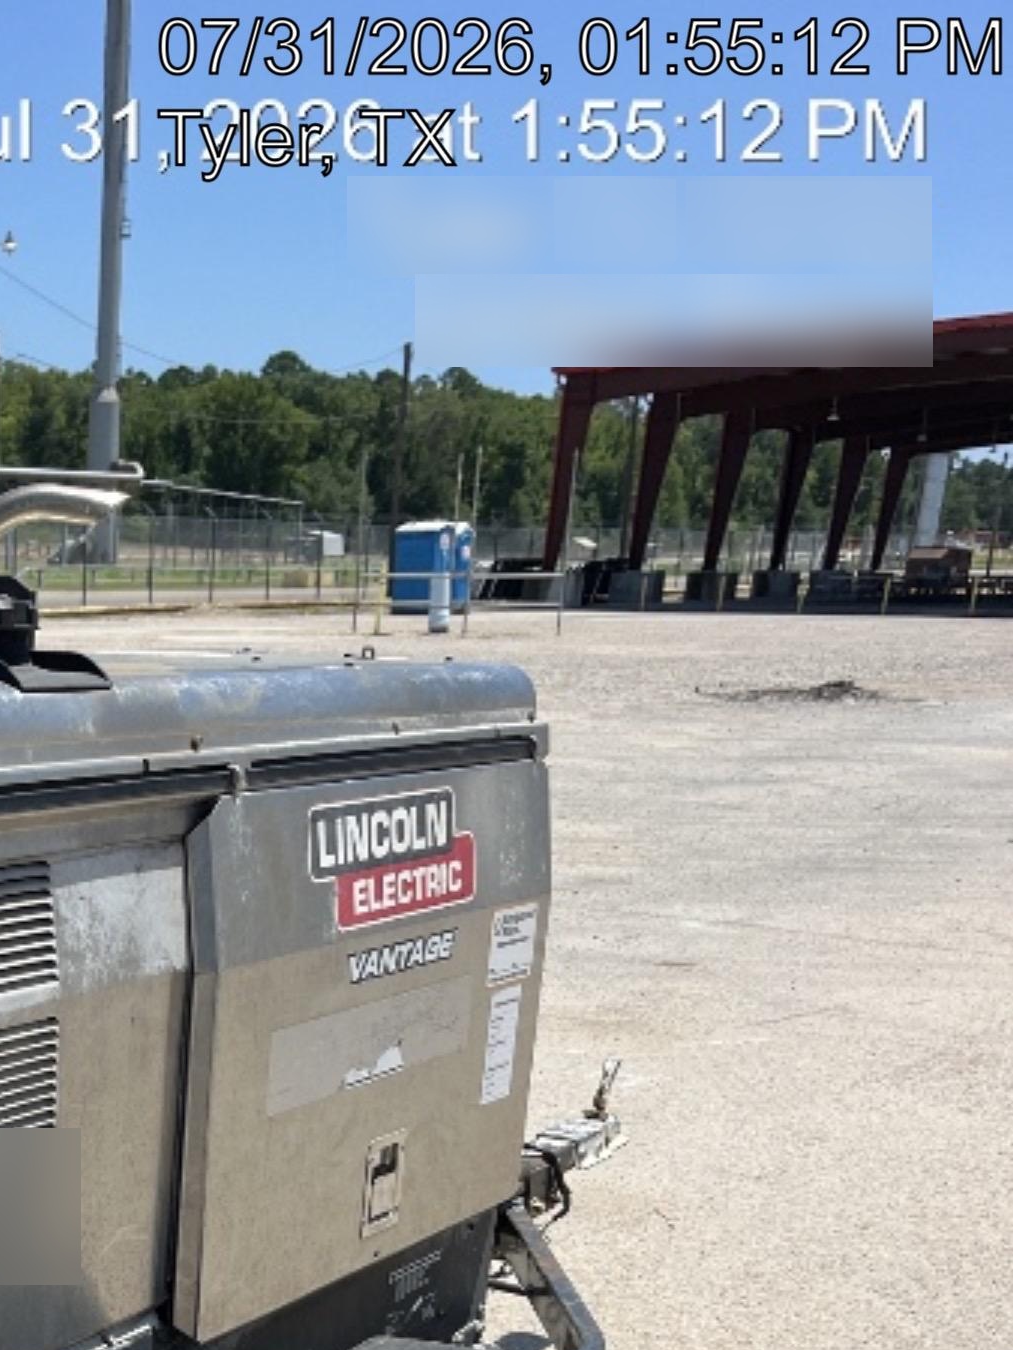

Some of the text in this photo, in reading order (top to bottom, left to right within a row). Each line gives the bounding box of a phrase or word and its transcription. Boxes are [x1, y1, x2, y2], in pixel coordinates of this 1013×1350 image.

[316, 800, 448, 869] LINCOLN
[352, 860, 463, 915] ELECTRIC
[348, 930, 455, 984] VANTAGE
